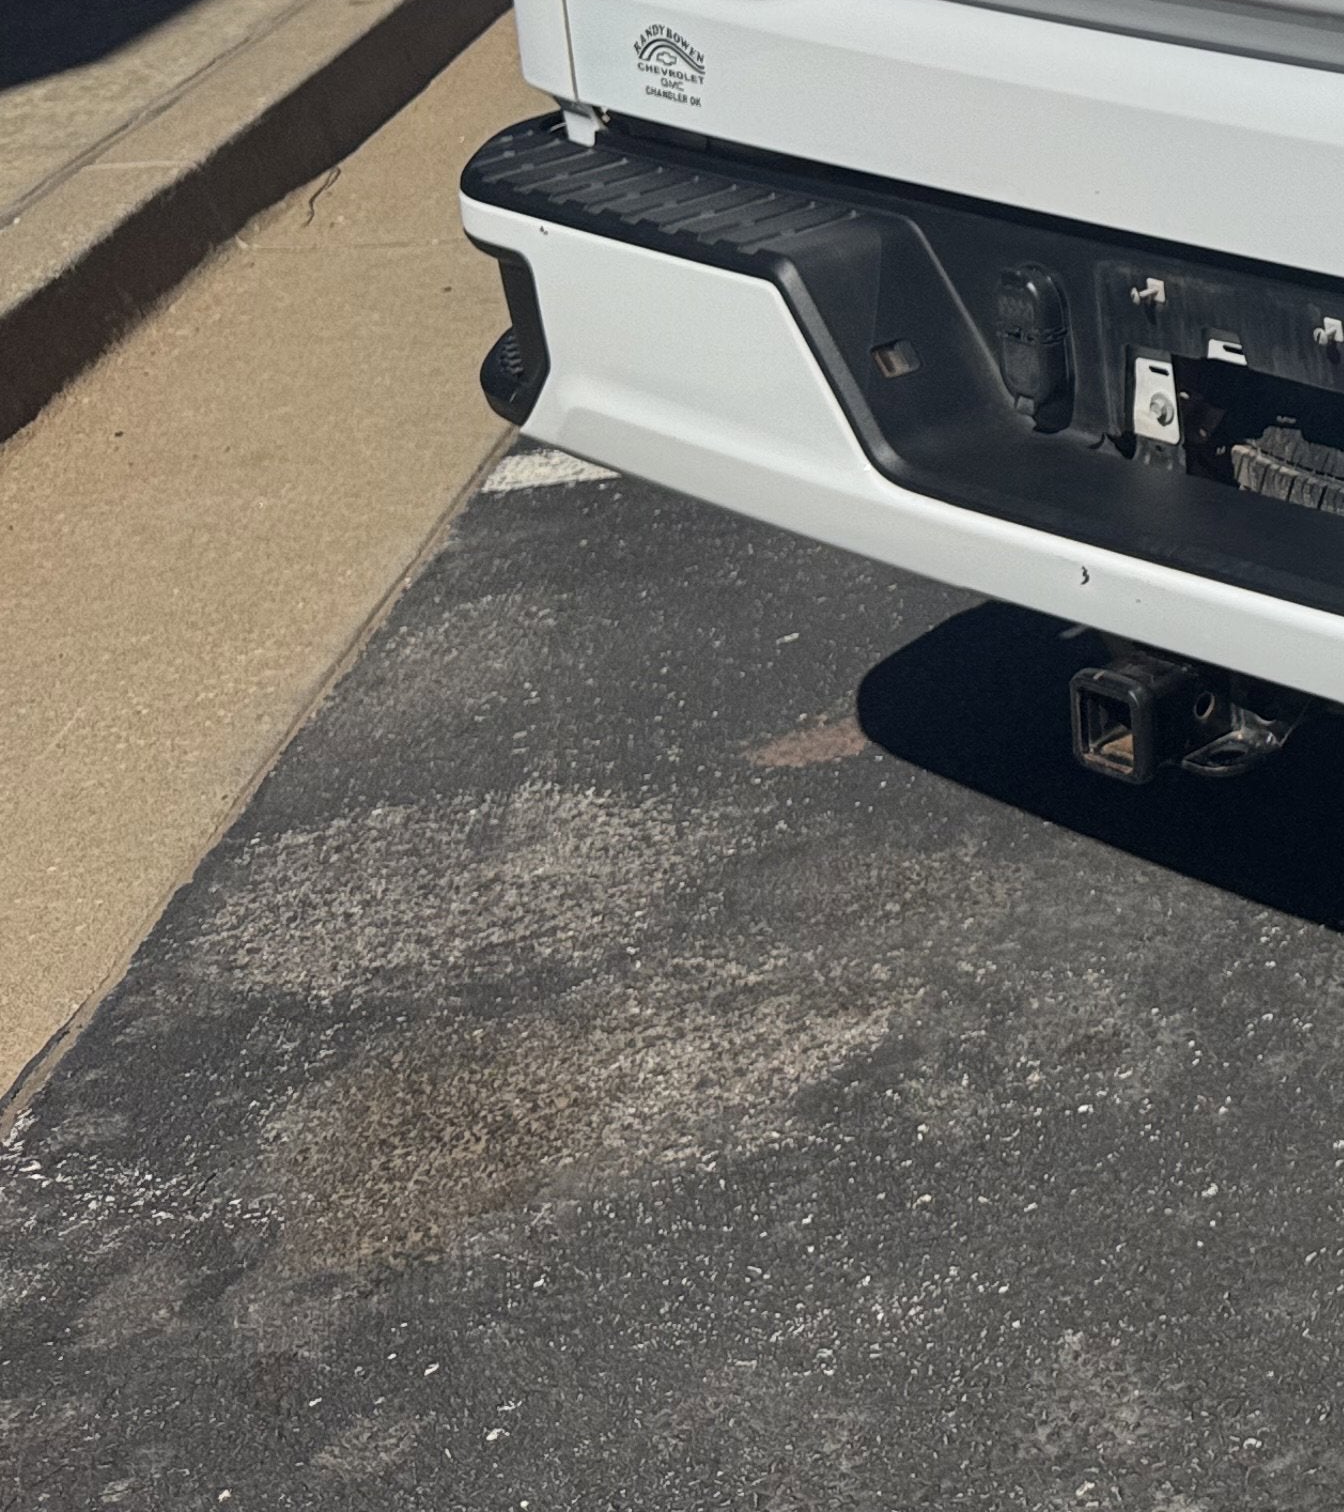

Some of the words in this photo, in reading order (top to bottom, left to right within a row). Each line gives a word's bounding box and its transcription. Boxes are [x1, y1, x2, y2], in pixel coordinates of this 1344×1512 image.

[633, 24, 666, 55] RANDY
[666, 27, 704, 64] BOWEN
[637, 62, 704, 85] CHEVROLET
[660, 77, 684, 92] GMC
[645, 85, 688, 104] CHANDLER
[690, 96, 702, 107] OK
